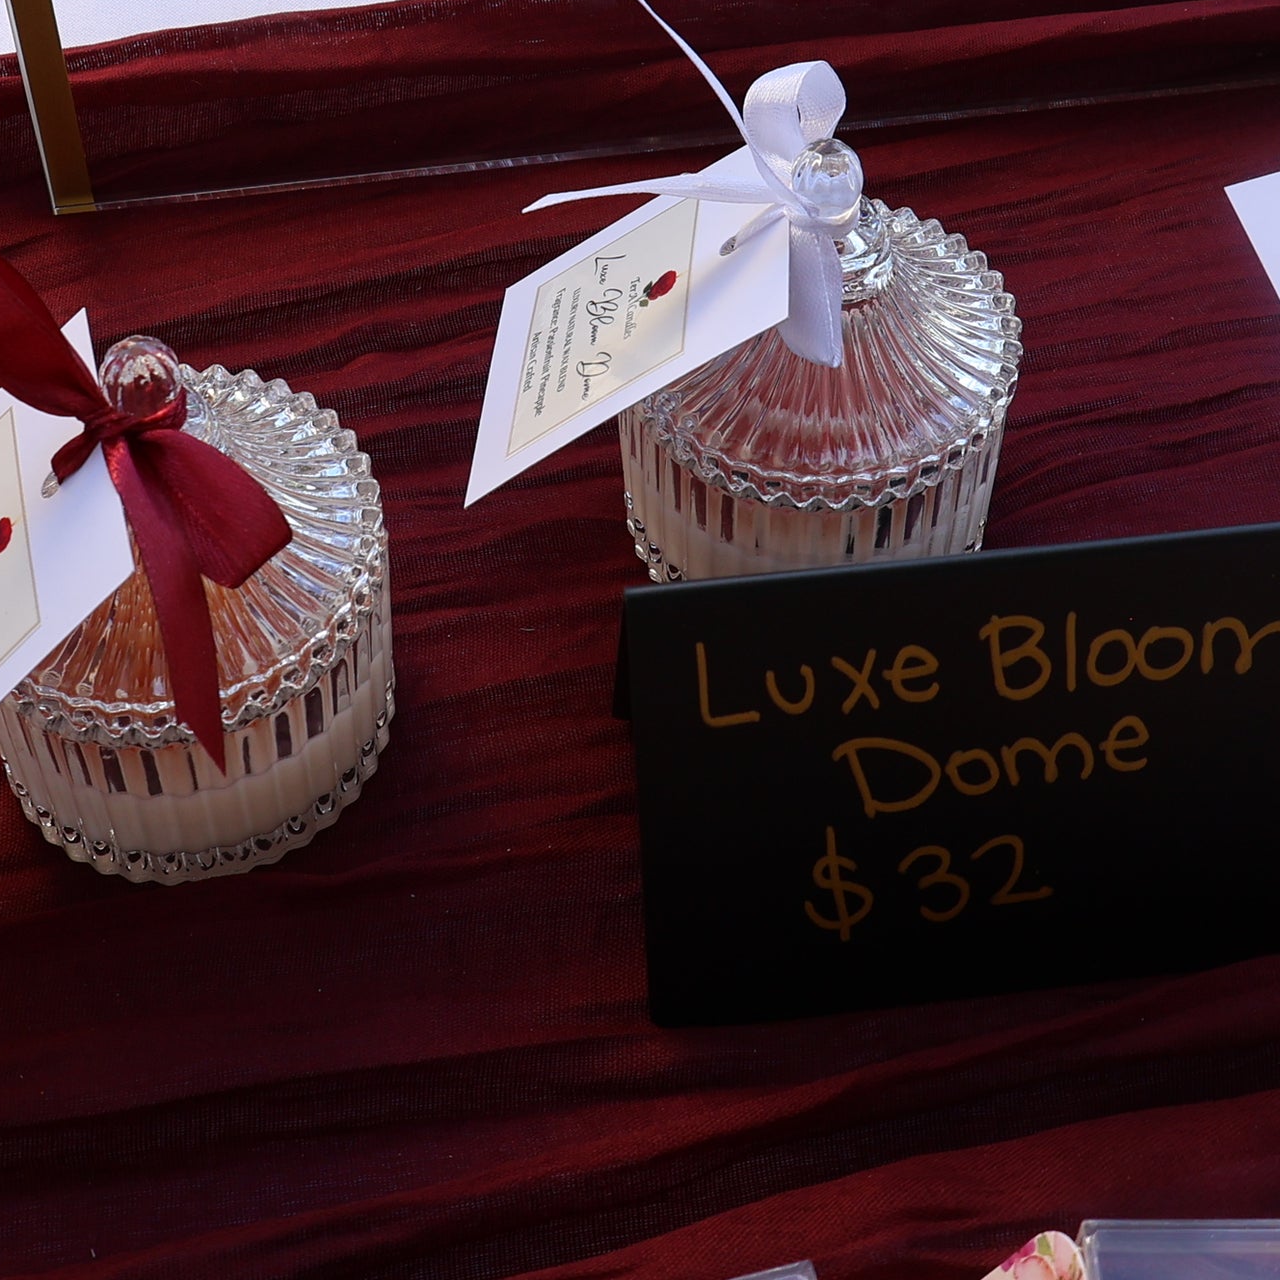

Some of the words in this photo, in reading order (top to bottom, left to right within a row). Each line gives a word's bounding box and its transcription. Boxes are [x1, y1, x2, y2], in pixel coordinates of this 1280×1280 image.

[594, 254, 627, 285] Luxe
[549, 287, 566, 329] Fragrance:
[569, 287, 581, 316] LUXURY
[585, 288, 623, 346] Bloom
[623, 299, 640, 340] Candles
[528, 331, 543, 361] Artisan
[540, 326, 559, 376] Passionfruit
[563, 314, 577, 349] NATURAL
[522, 359, 537, 394] Crafted
[560, 346, 571, 367] WAX
[576, 351, 612, 401] Dome
[533, 373, 551, 418] Pineapple
[556, 364, 568, 393] BLEND
[696, 642, 940, 727] Luxe
[833, 715, 1149, 818] Dome
